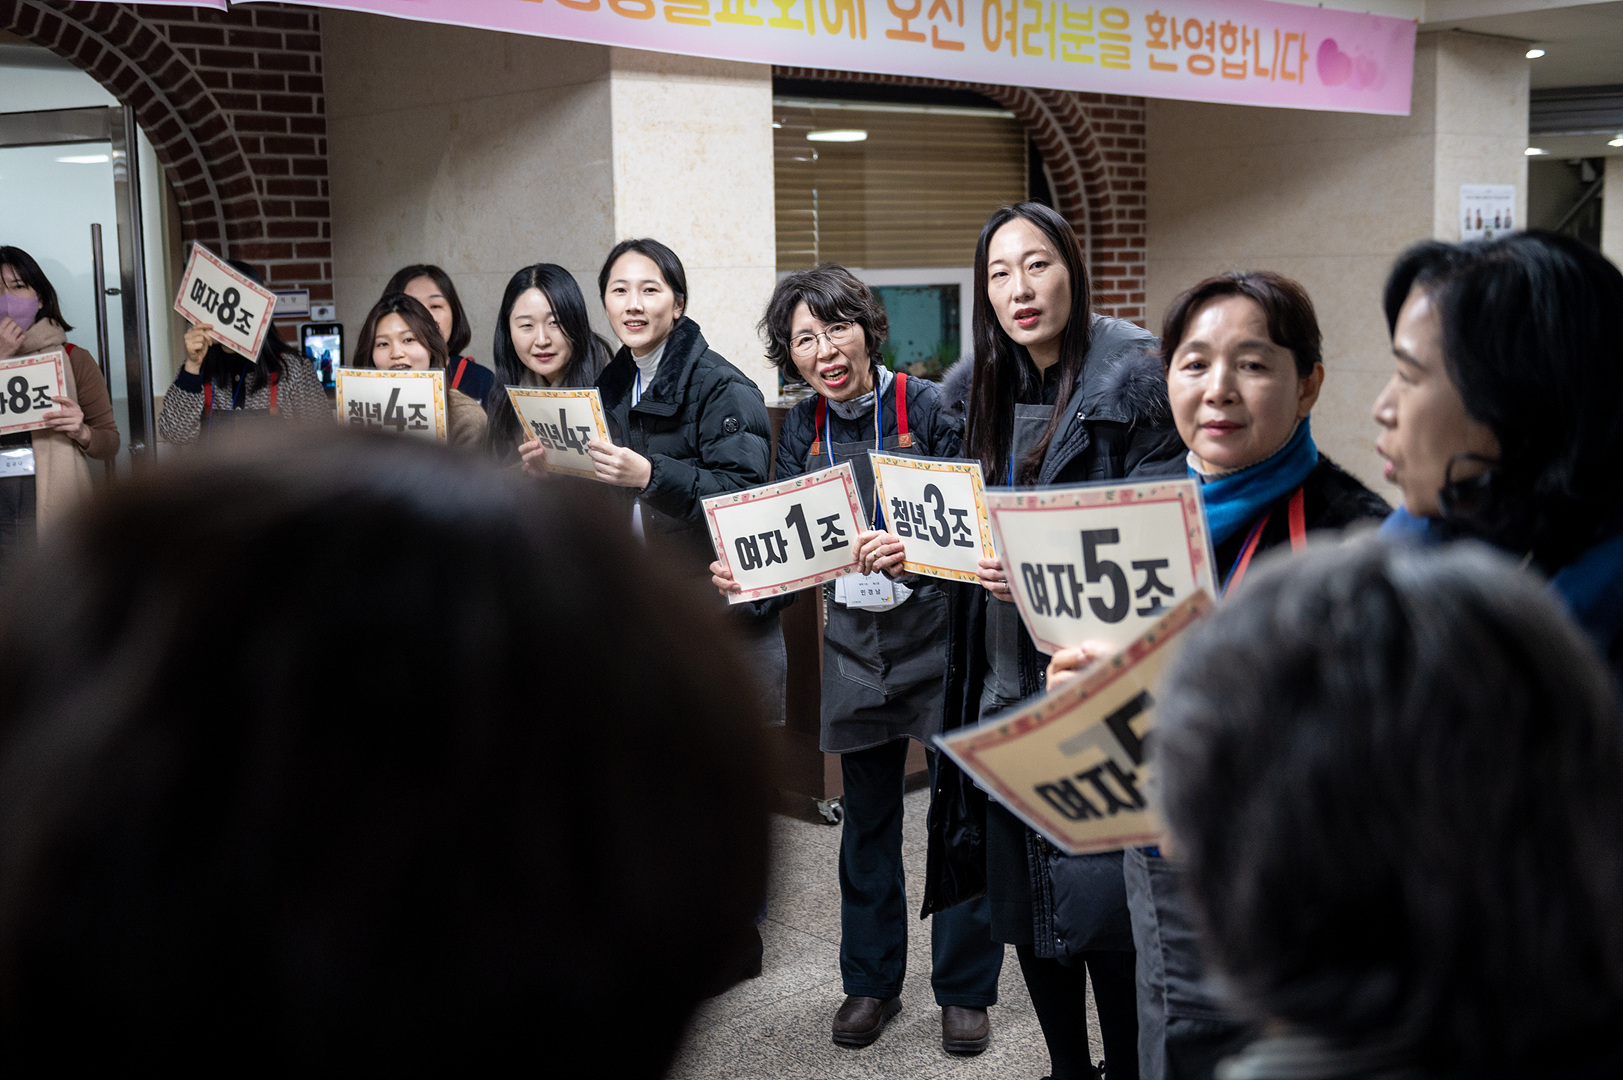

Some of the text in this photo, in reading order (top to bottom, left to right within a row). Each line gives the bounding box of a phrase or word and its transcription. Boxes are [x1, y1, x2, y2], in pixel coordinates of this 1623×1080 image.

[886, 0, 965, 52] 오신
[982, 0, 1131, 70] 여러분을
[1145, 10, 1309, 84] 환영합니다
[190, 277, 255, 336] 여자8조
[348, 387, 429, 432] 청년4조
[530, 408, 593, 456] 청년4조
[734, 503, 849, 571] 여자1조
[891, 483, 975, 549] 청년3조
[1020, 528, 1175, 624] 여자5조
